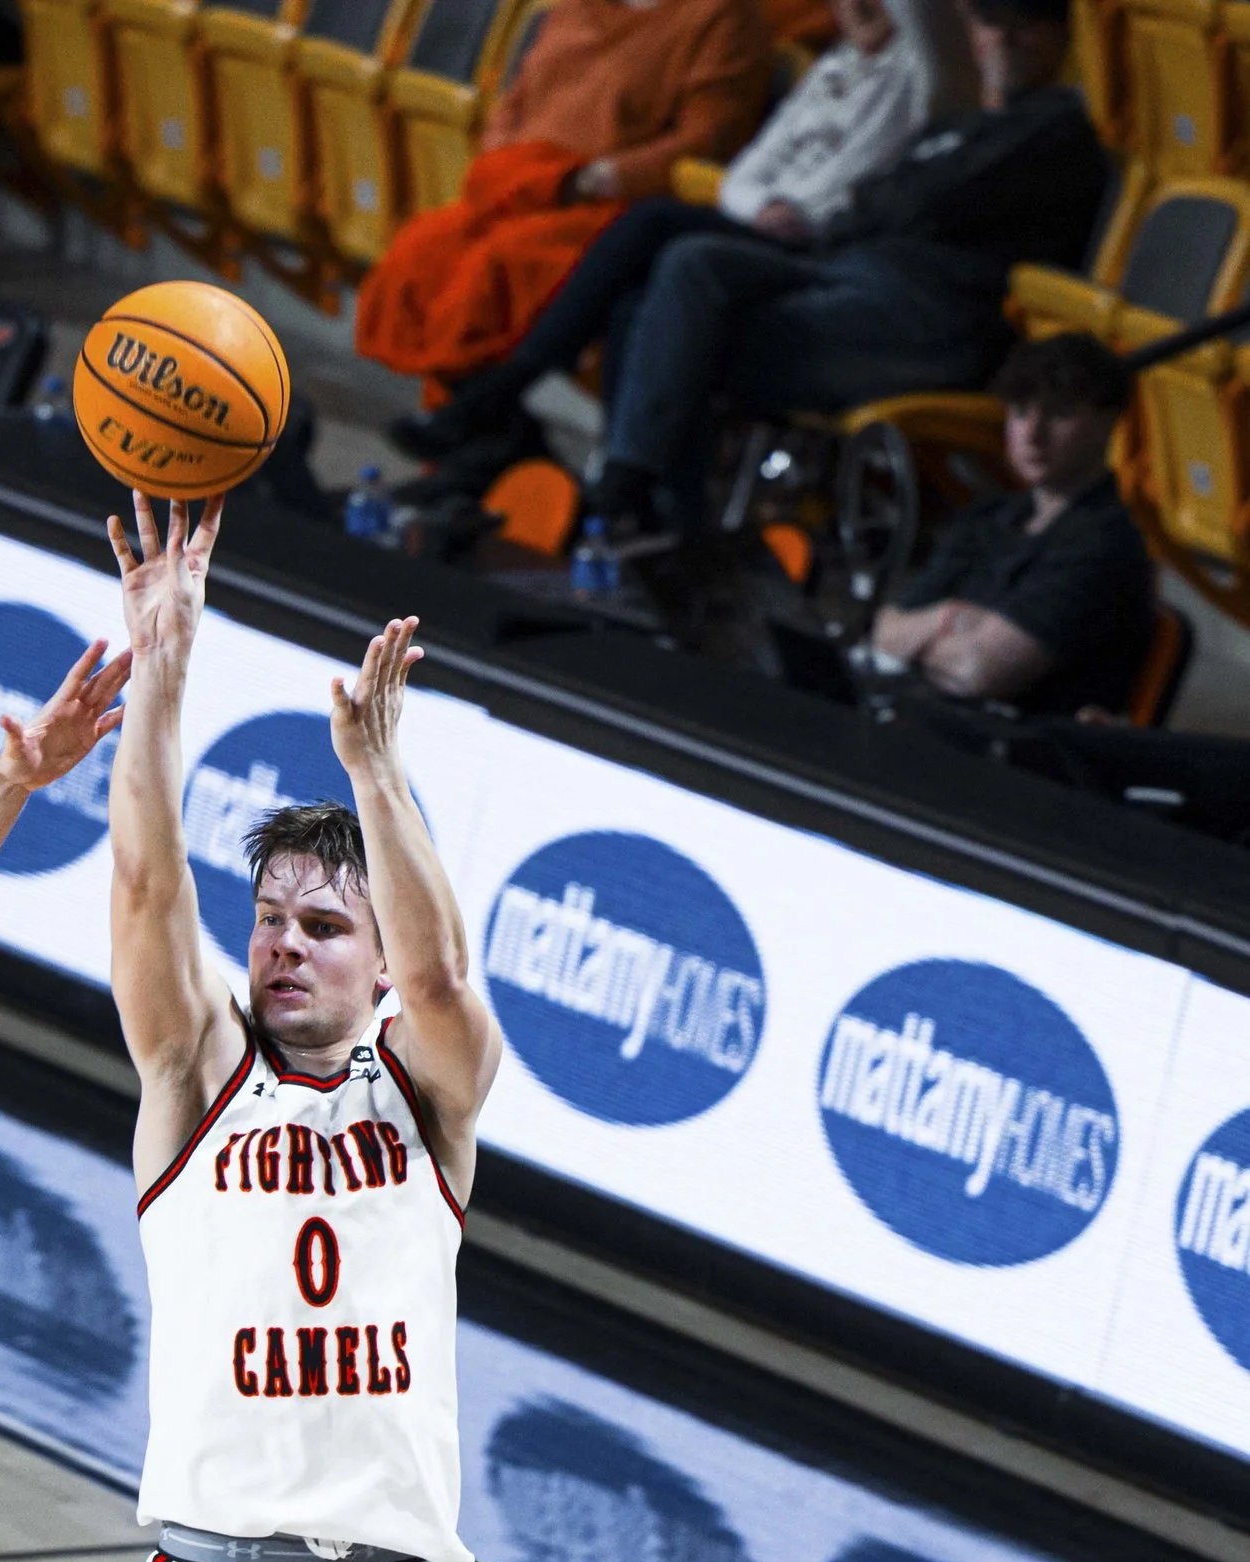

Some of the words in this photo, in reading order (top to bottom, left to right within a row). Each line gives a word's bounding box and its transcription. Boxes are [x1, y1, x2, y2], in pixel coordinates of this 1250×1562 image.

[107, 331, 229, 428] Wilson
[292, 1216, 341, 1308] 0
[233, 1321, 411, 1397] CAMELS
